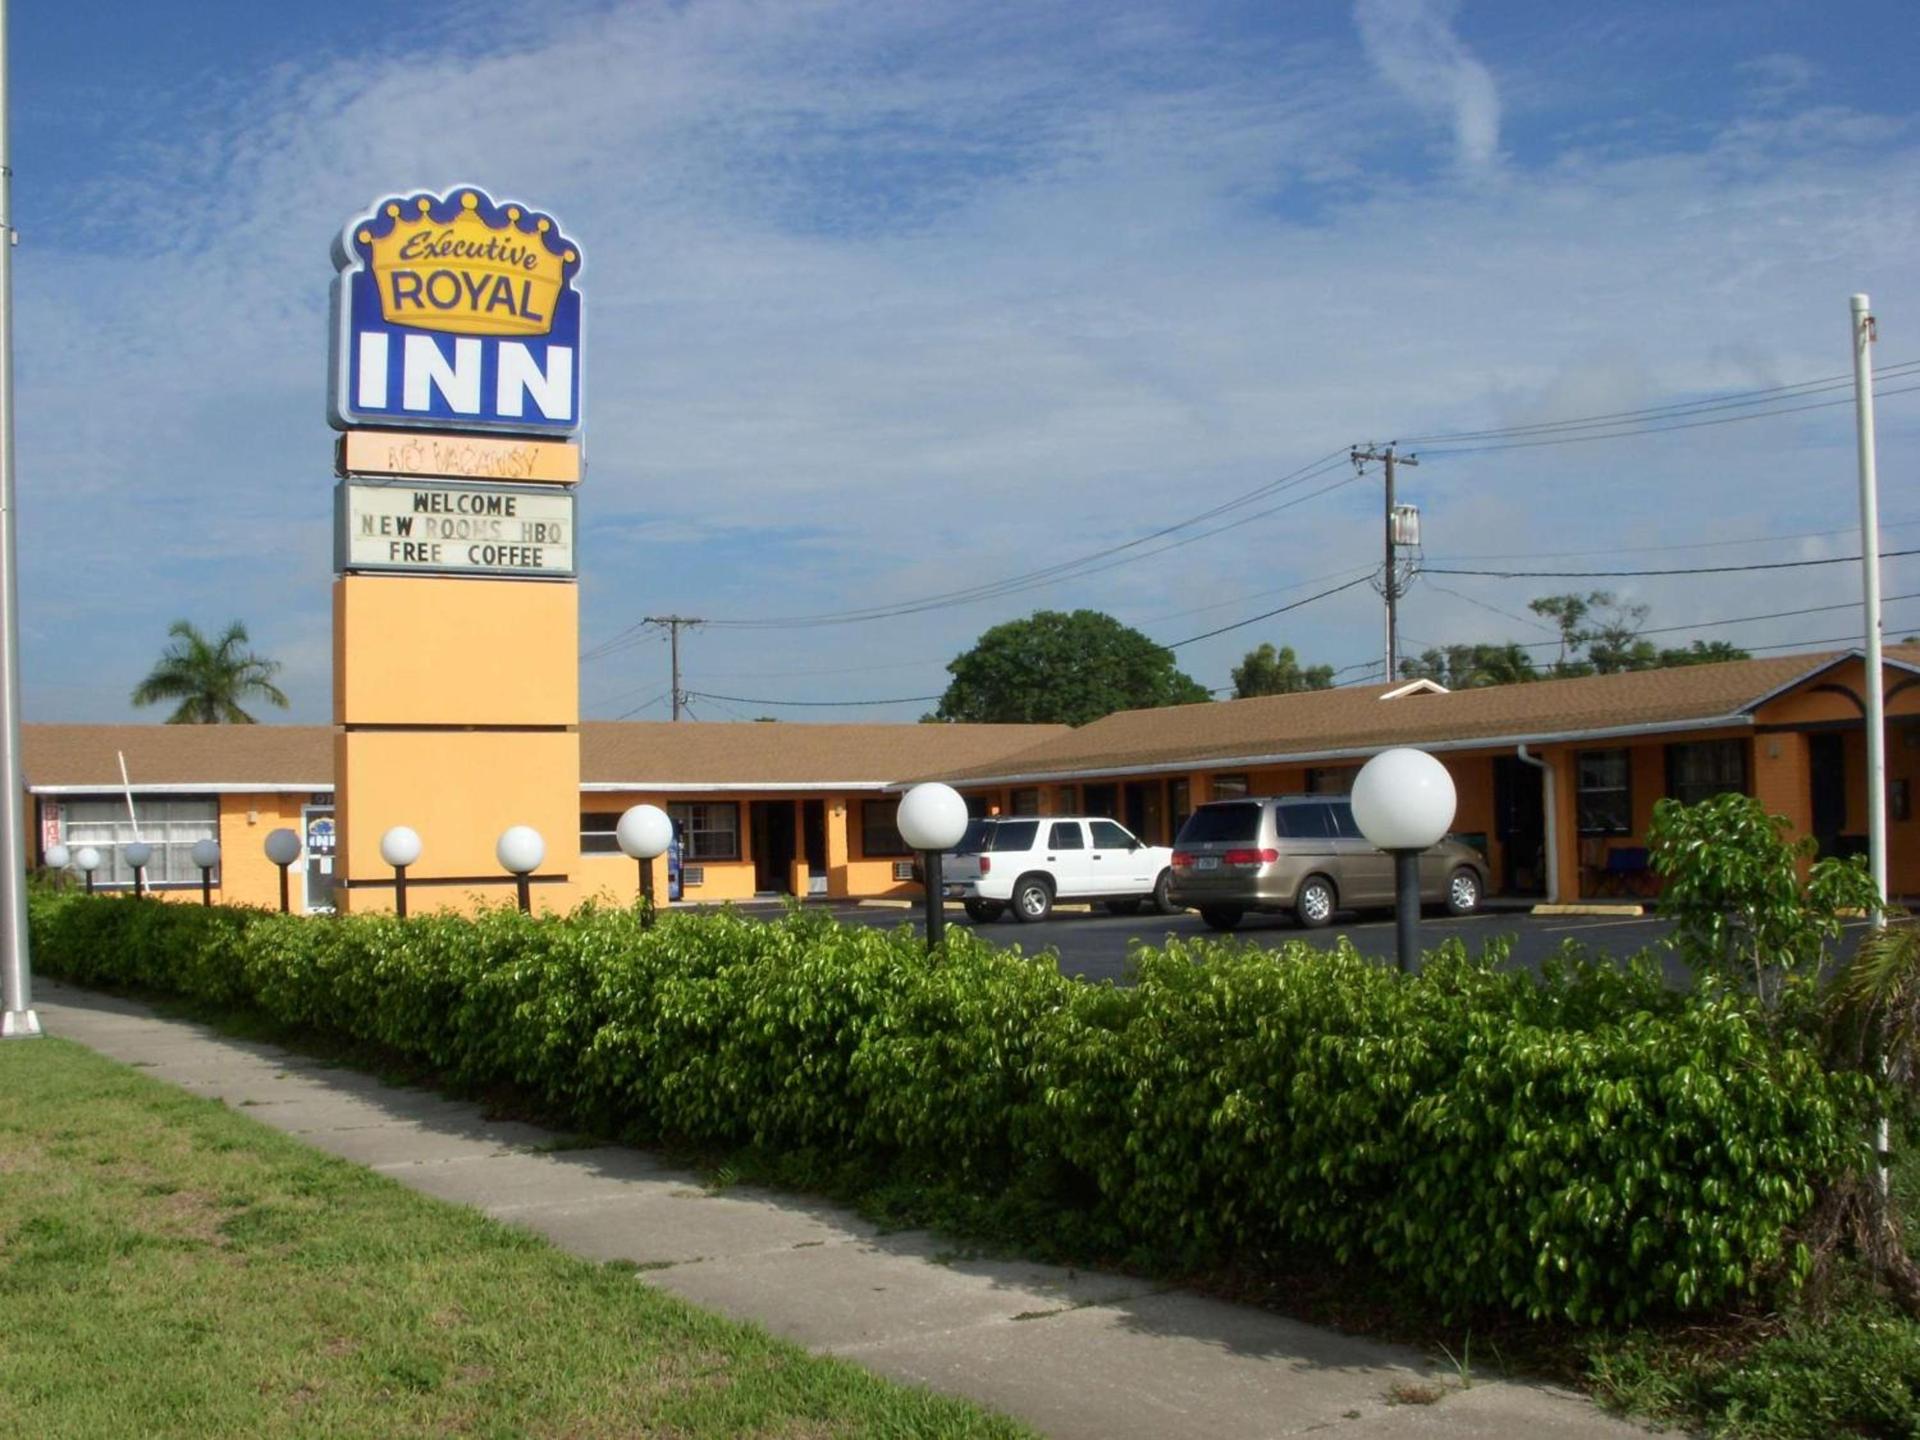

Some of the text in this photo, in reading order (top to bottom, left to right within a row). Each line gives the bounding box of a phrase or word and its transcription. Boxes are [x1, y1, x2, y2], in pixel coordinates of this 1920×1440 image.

[399, 229, 538, 271] Executive
[390, 269, 544, 322] ROYAL
[358, 331, 573, 420] INN
[413, 492, 517, 517] WELCOME
[362, 515, 562, 544] NEW ROOMS HBO
[389, 541, 543, 568] FREE COFFEE
